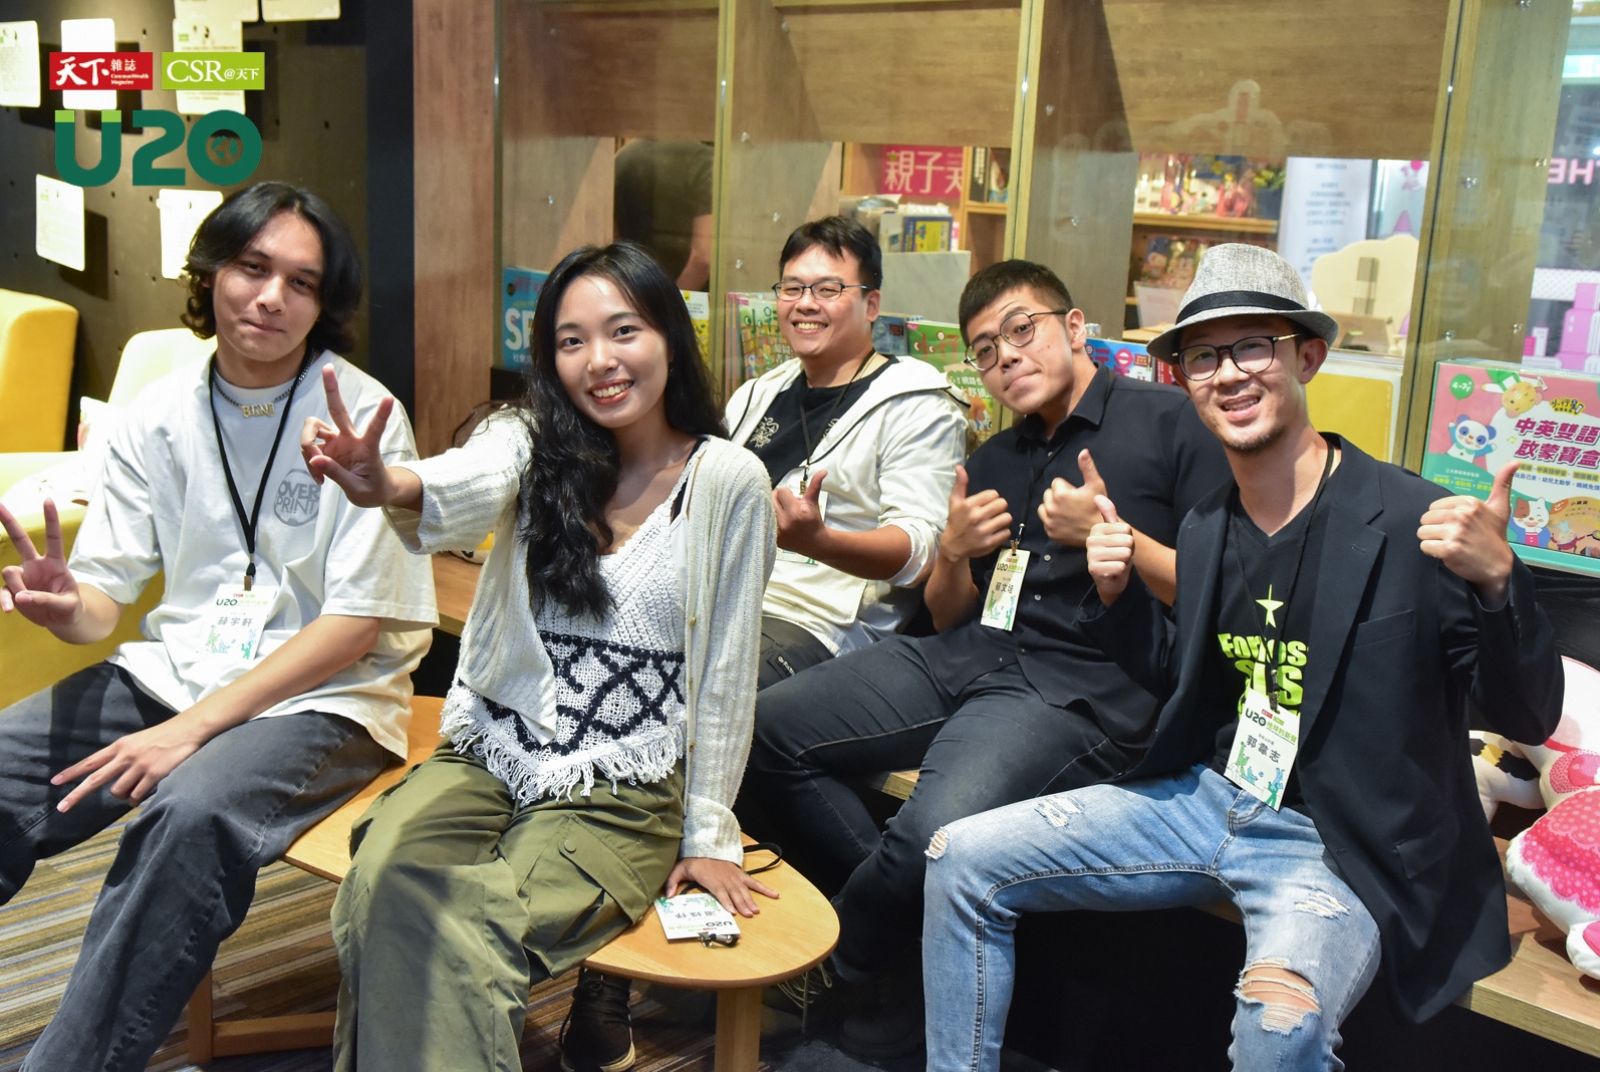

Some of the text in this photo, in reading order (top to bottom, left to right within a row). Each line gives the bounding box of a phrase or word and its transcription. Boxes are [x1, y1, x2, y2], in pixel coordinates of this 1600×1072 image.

[1515, 417, 1600, 444] 中英雙語
[278, 480, 321, 501] OVER
[277, 496, 317, 514] PRINT
